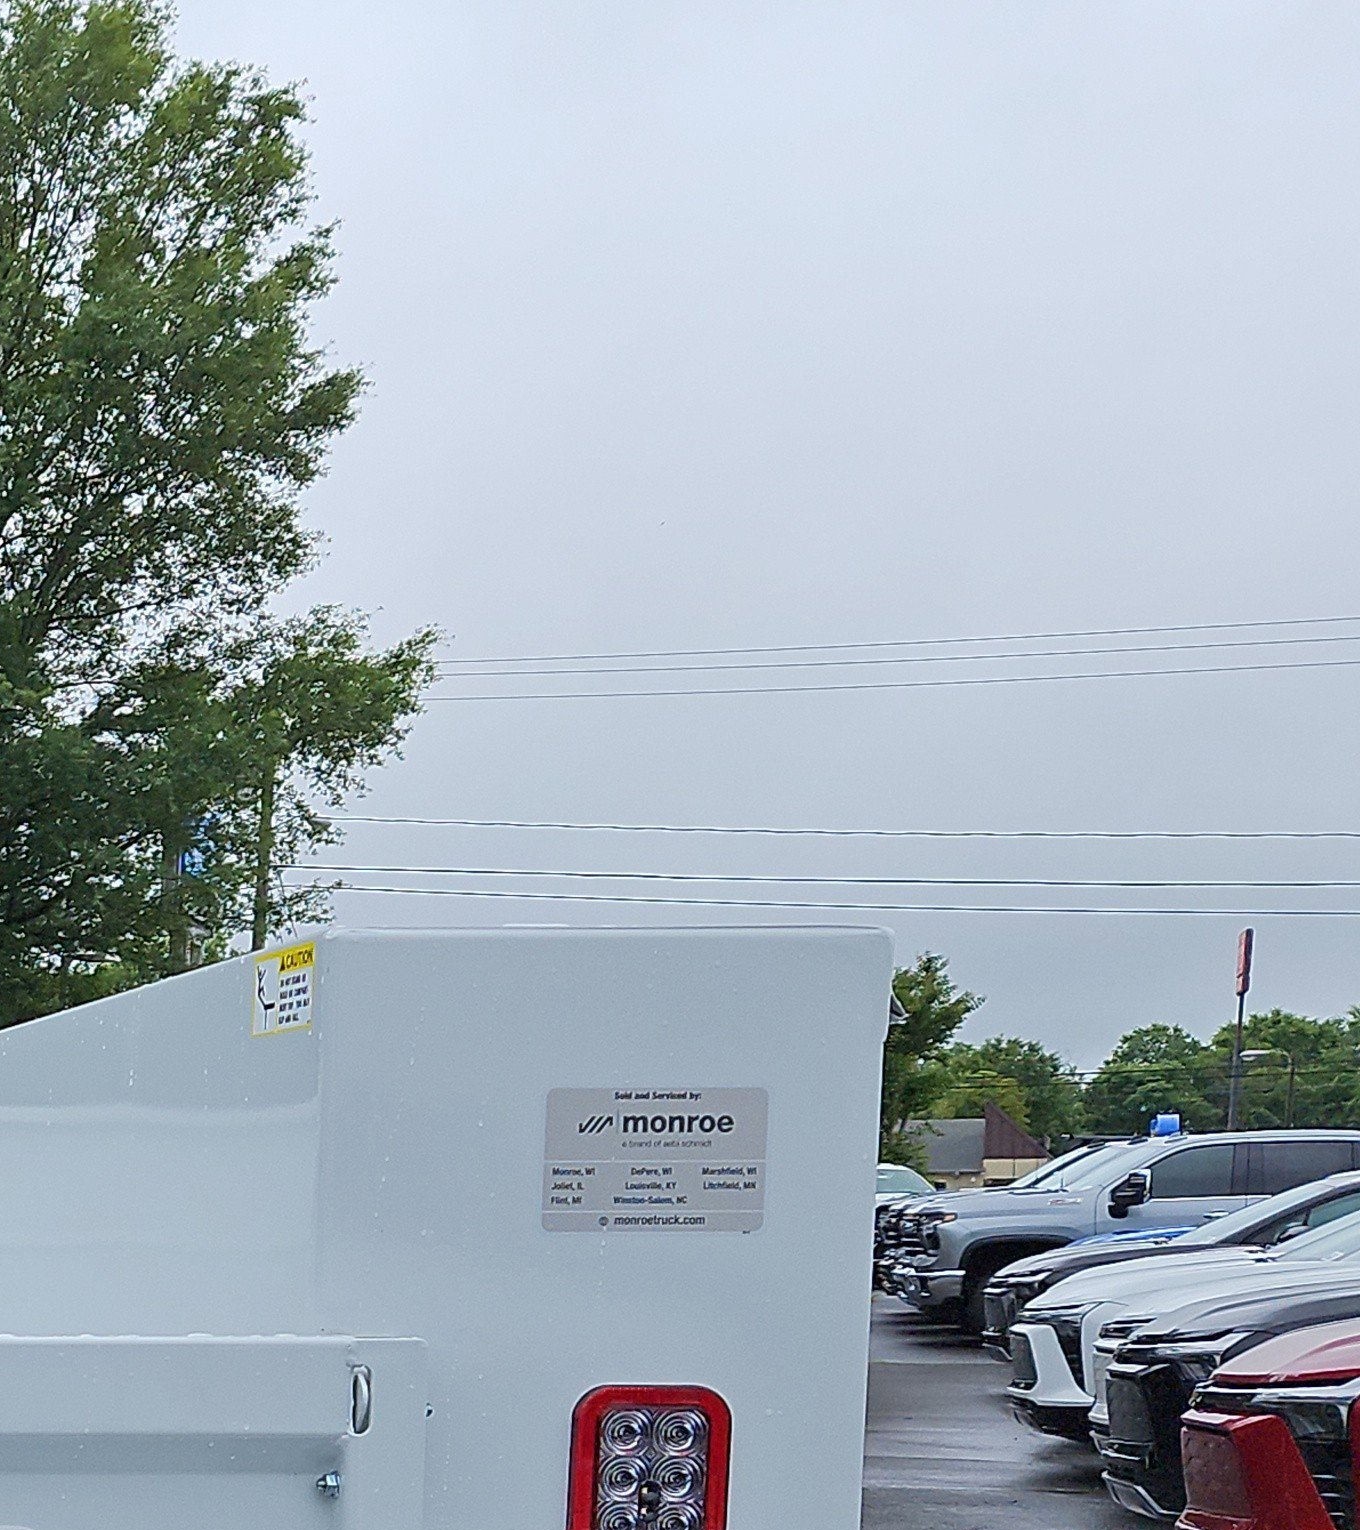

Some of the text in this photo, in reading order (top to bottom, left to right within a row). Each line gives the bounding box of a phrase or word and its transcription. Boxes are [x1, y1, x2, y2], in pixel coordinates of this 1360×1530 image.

[614, 1091, 702, 1102] Sold and Serviced by:
[622, 1114, 735, 1133] monroe
[552, 1167, 583, 1177] Monroe,
[662, 1167, 673, 1176] WI
[746, 1167, 757, 1176] WI
[551, 1182, 575, 1191] Joliet,
[625, 1181, 677, 1191] Louisville, KY
[550, 1196, 570, 1205] Flint,
[676, 1196, 688, 1204] NC
[613, 1215, 706, 1225] monroetruck.com
